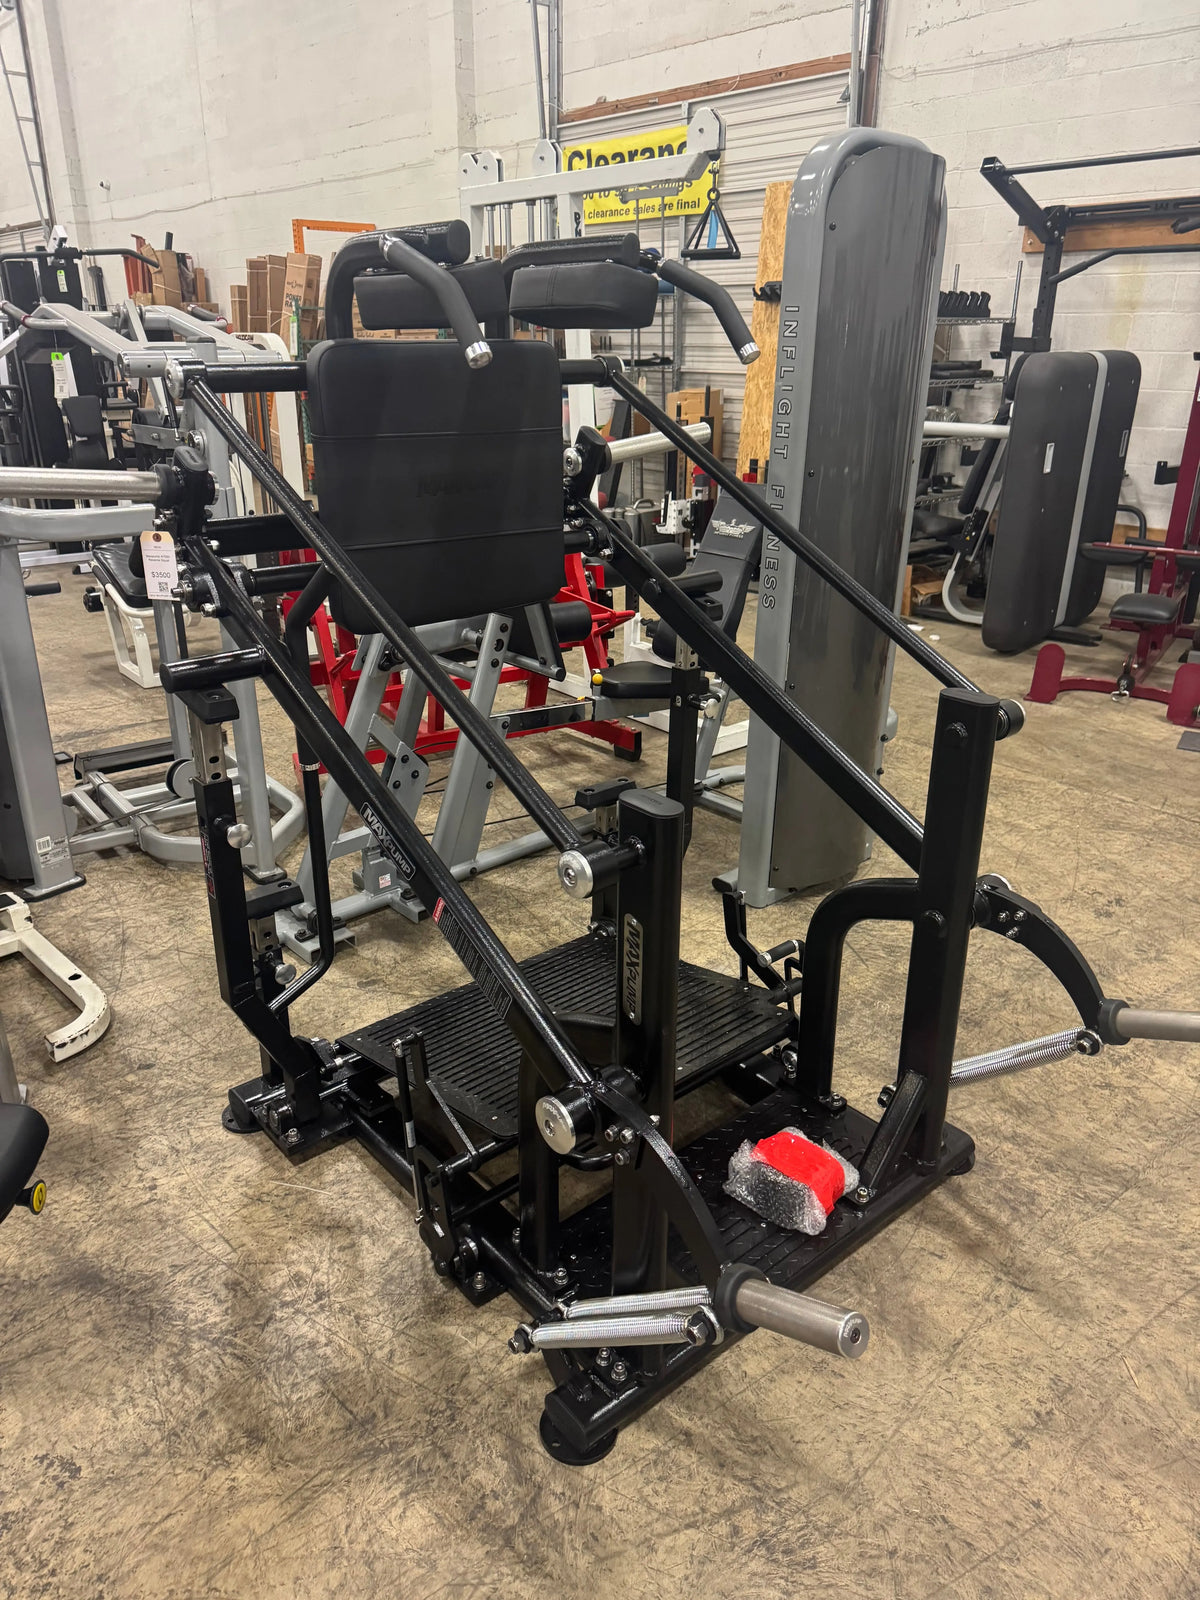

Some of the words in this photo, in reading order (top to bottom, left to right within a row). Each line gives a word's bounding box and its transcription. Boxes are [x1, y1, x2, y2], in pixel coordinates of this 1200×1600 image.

[588, 208, 630, 219] clearance
[633, 203, 655, 215] sales
[676, 198, 701, 210] final
[774, 305, 800, 459] INFLIGHT
[151, 571, 171, 579] $3500
[761, 484, 785, 610] FINESS
[363, 807, 411, 874] MAXPUMP
[626, 920, 640, 1014] MAXPUMP
